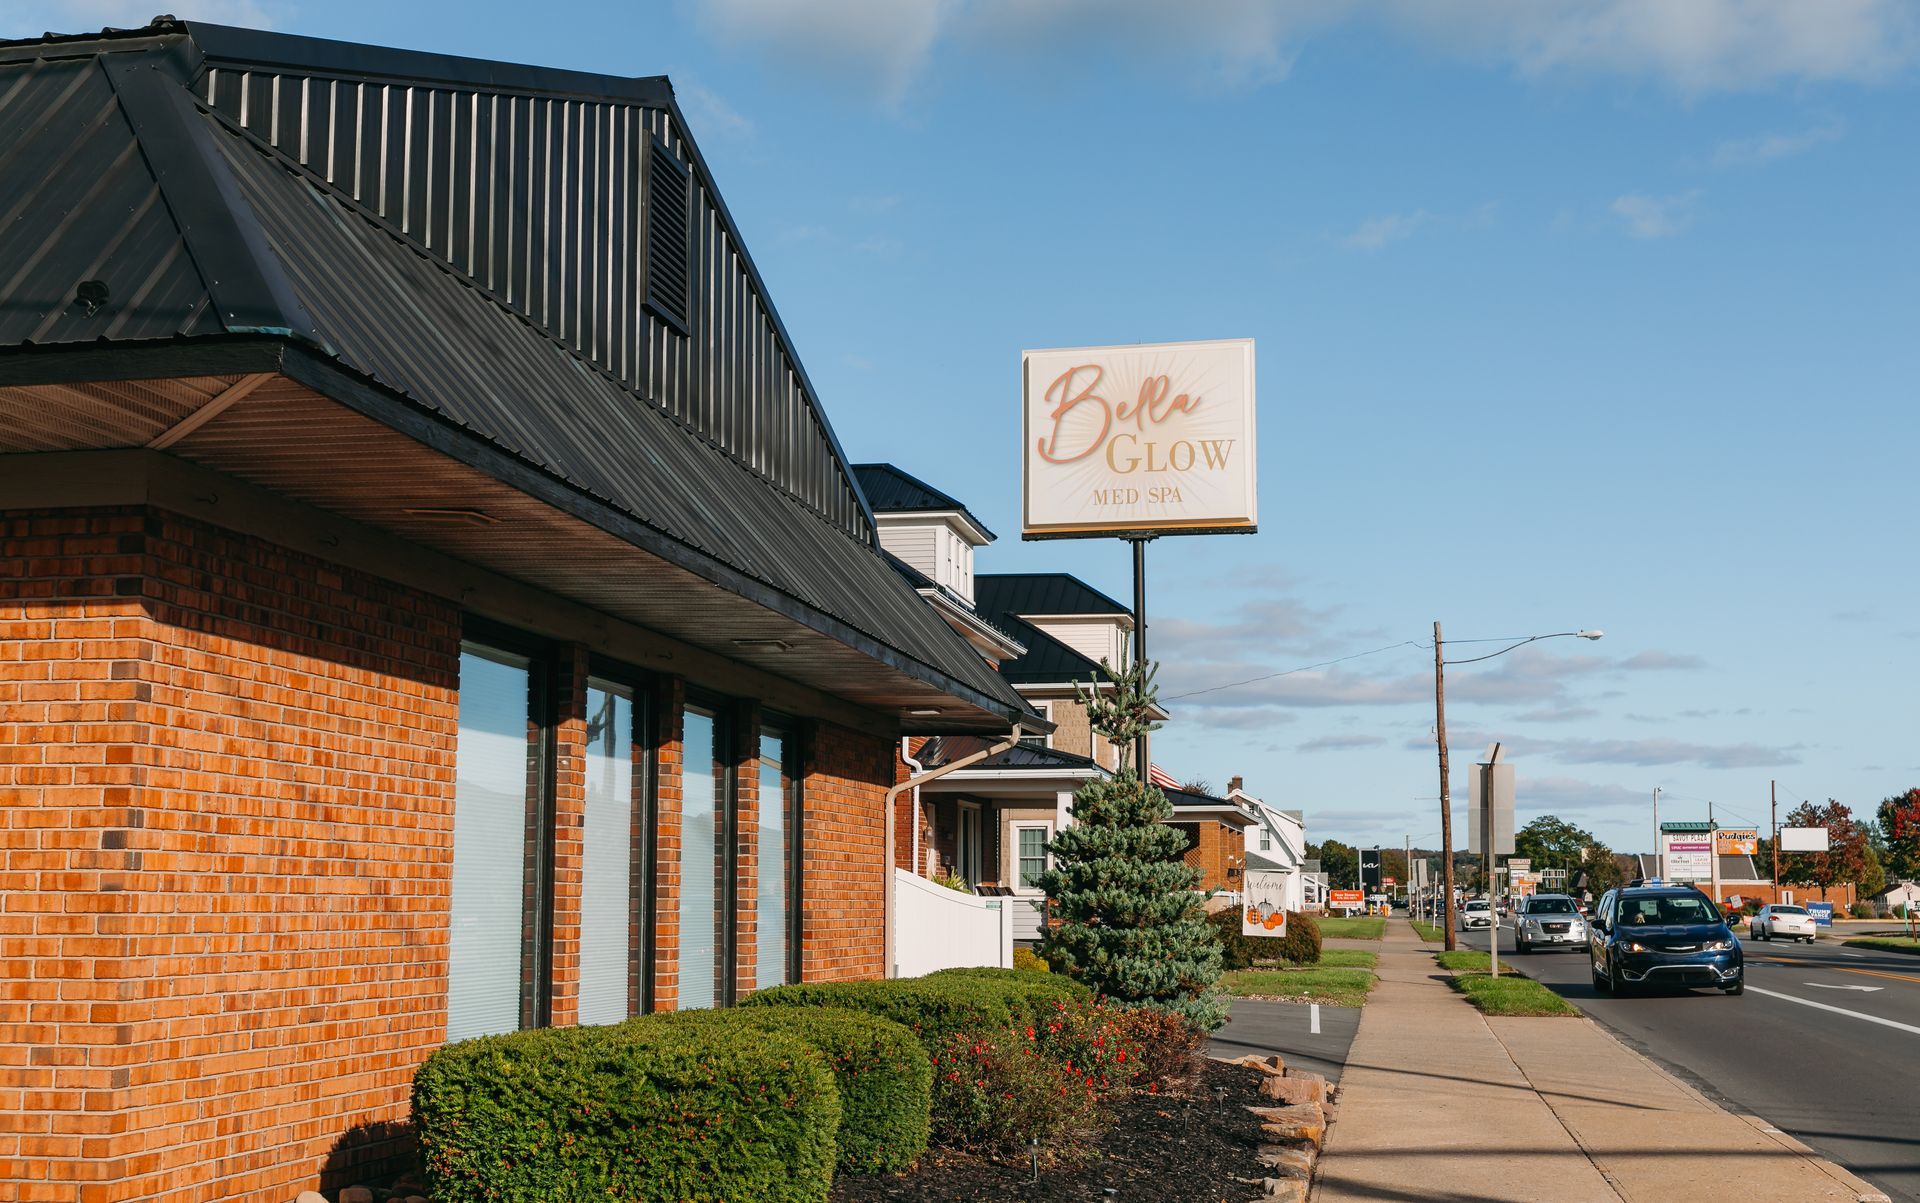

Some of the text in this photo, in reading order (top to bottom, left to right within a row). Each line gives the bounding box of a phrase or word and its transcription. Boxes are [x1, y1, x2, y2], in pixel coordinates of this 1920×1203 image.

[1038, 364, 1201, 464] Bella
[1106, 433, 1236, 474] GLOW
[1093, 487, 1183, 506] MED SPA
[1691, 833, 1708, 842] PLAZA
[1247, 874, 1283, 889] welcome
